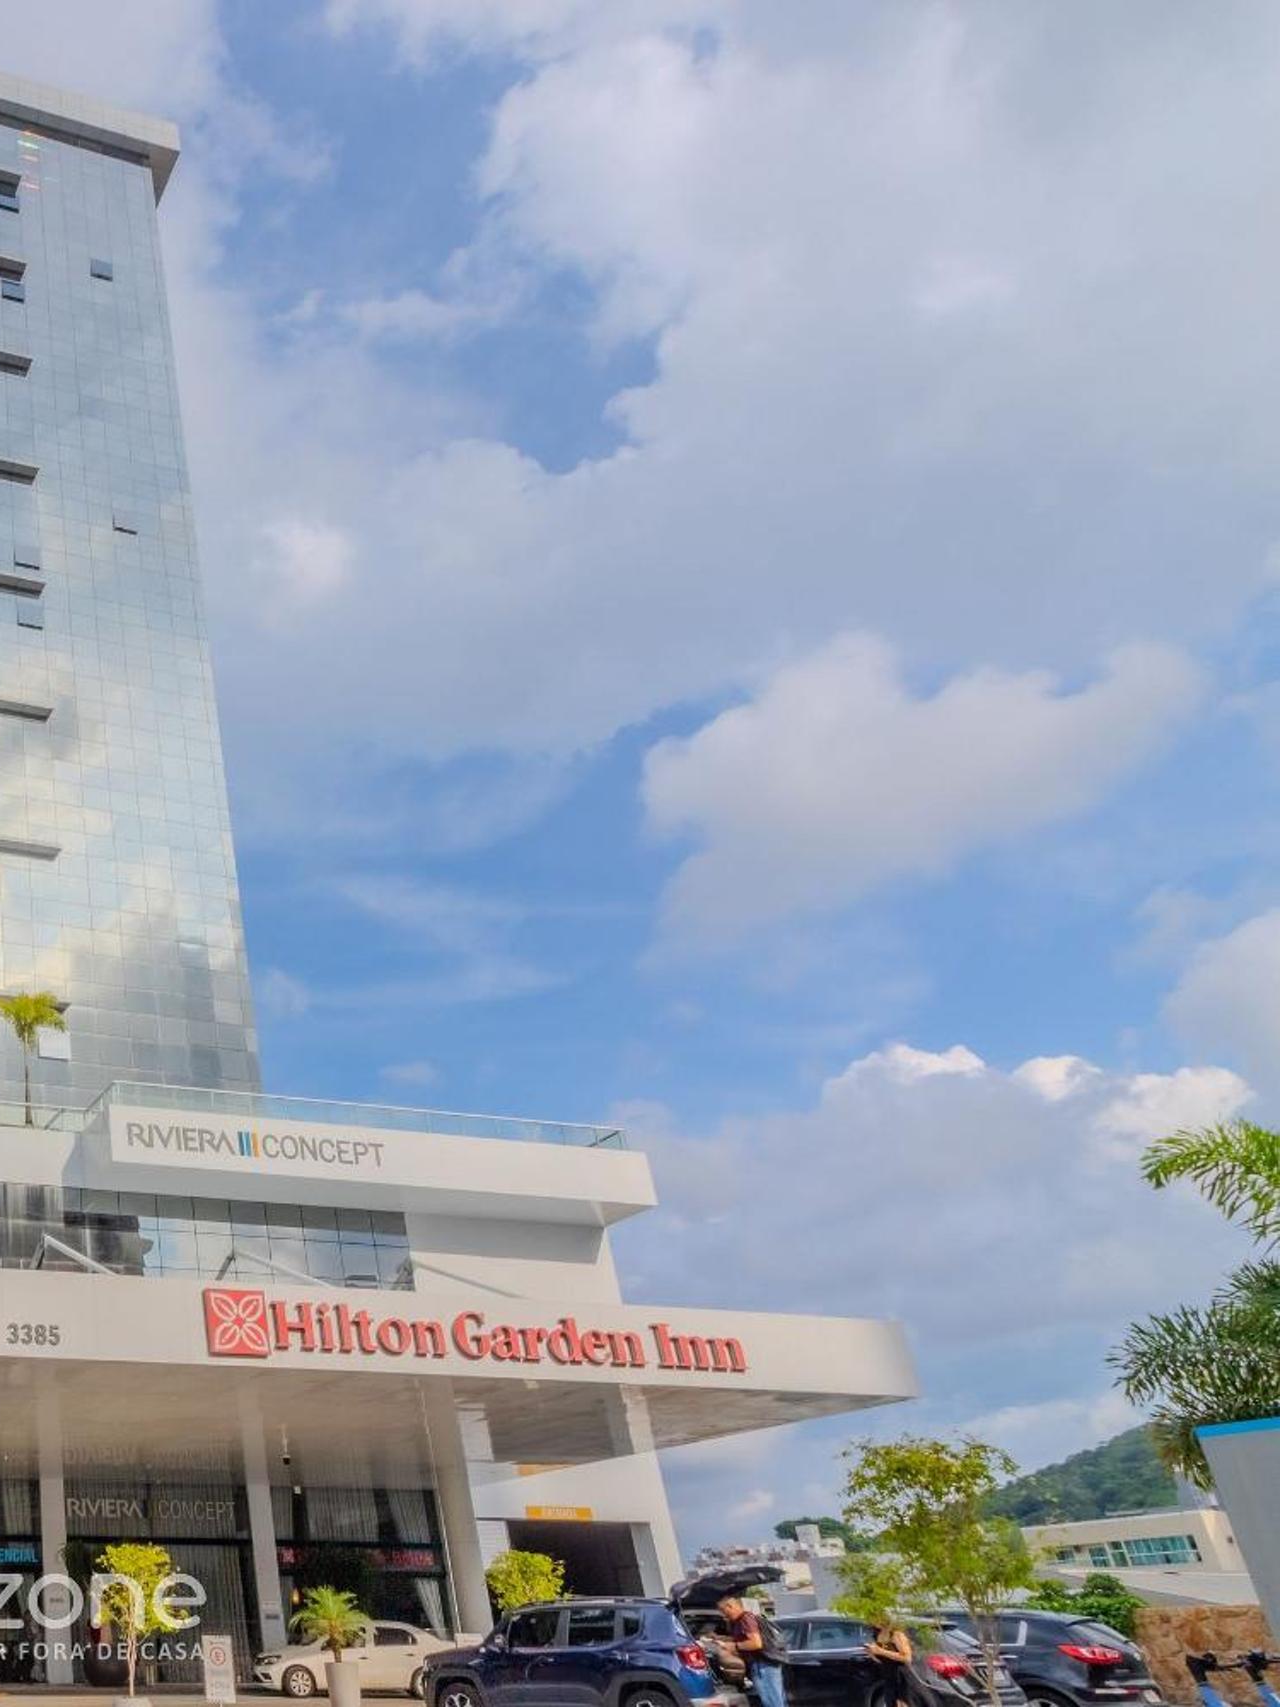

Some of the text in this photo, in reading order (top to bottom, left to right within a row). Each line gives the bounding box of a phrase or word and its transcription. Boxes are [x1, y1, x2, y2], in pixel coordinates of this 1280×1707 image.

[125, 1121, 384, 1167] RIVIERA CONCEPT
[5, 1322, 61, 1347] 3385
[269, 1300, 747, 1373] Hilton Garden Inn
[66, 1497, 236, 1521] RIVIERA CONCEPT
